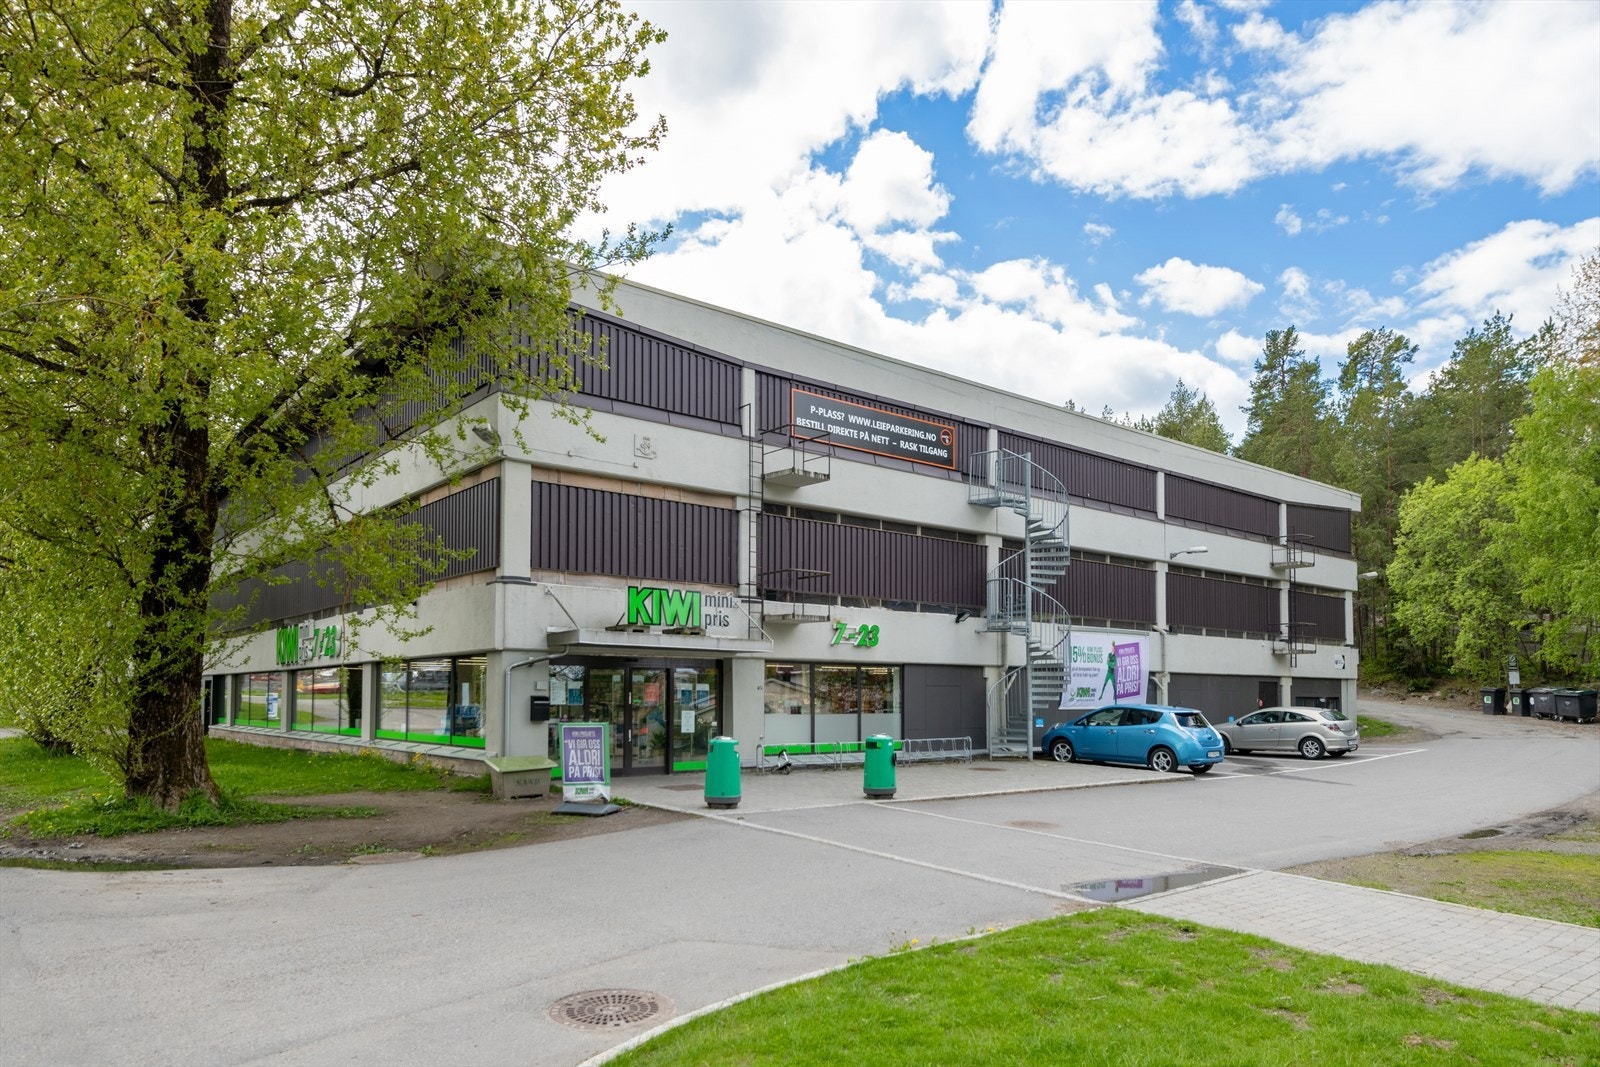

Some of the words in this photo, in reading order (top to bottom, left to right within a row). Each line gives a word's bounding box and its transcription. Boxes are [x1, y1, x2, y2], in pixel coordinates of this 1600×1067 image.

[796, 417, 826, 431] BESTILL
[827, 424, 859, 439] DIREKTE
[859, 431, 870, 442] PÅ
[871, 434, 890, 445] NETT
[899, 440, 918, 452] RASK
[918, 444, 948, 458] TILGANG
[810, 405, 845, 421] P-PLASS?
[848, 414, 937, 442] WWW.LEIEPARKERING.NO
[628, 586, 702, 627] KIWI
[704, 592, 733, 608] mini
[704, 611, 730, 630] pris
[276, 624, 299, 664] KIWI
[831, 622, 880, 648] 7-23
[1117, 665, 1139, 682] ALDRI
[569, 750, 601, 766] ALDRI
